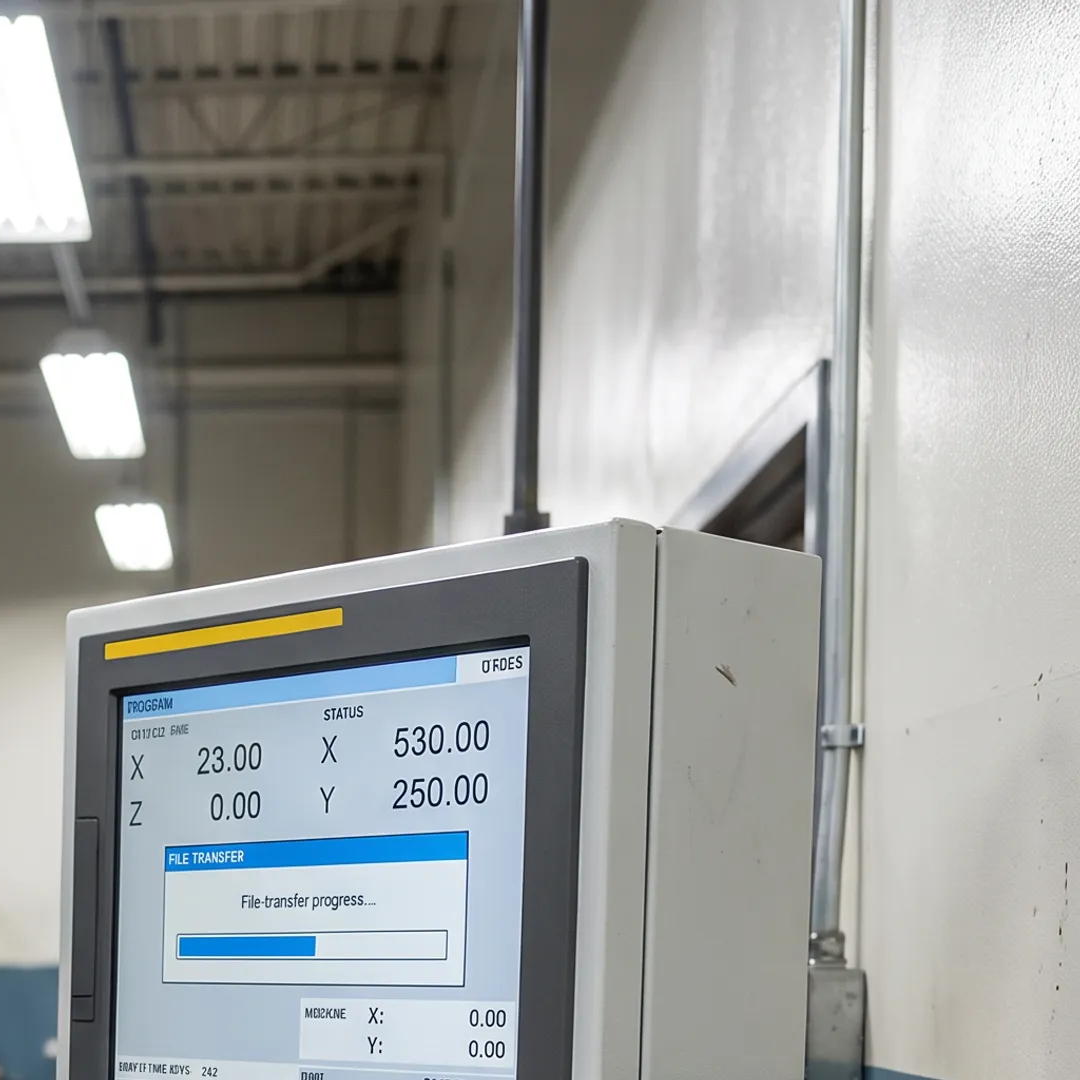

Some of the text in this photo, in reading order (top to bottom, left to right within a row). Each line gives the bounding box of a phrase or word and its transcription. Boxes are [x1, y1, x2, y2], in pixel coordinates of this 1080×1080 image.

[323, 705, 364, 721] STATUS
[320, 720, 490, 764] X 530.00
[130, 742, 262, 781] X 23.00
[320, 772, 489, 814] Y 250.00
[129, 790, 261, 827] Z 0.00
[168, 850, 245, 865] FILE TRANSFER
[241, 893, 309, 909] File-transfer
[368, 1007, 507, 1028] X: 0.00
[367, 1036, 506, 1059] Y: 0.00
[201, 1066, 219, 1077] 242
